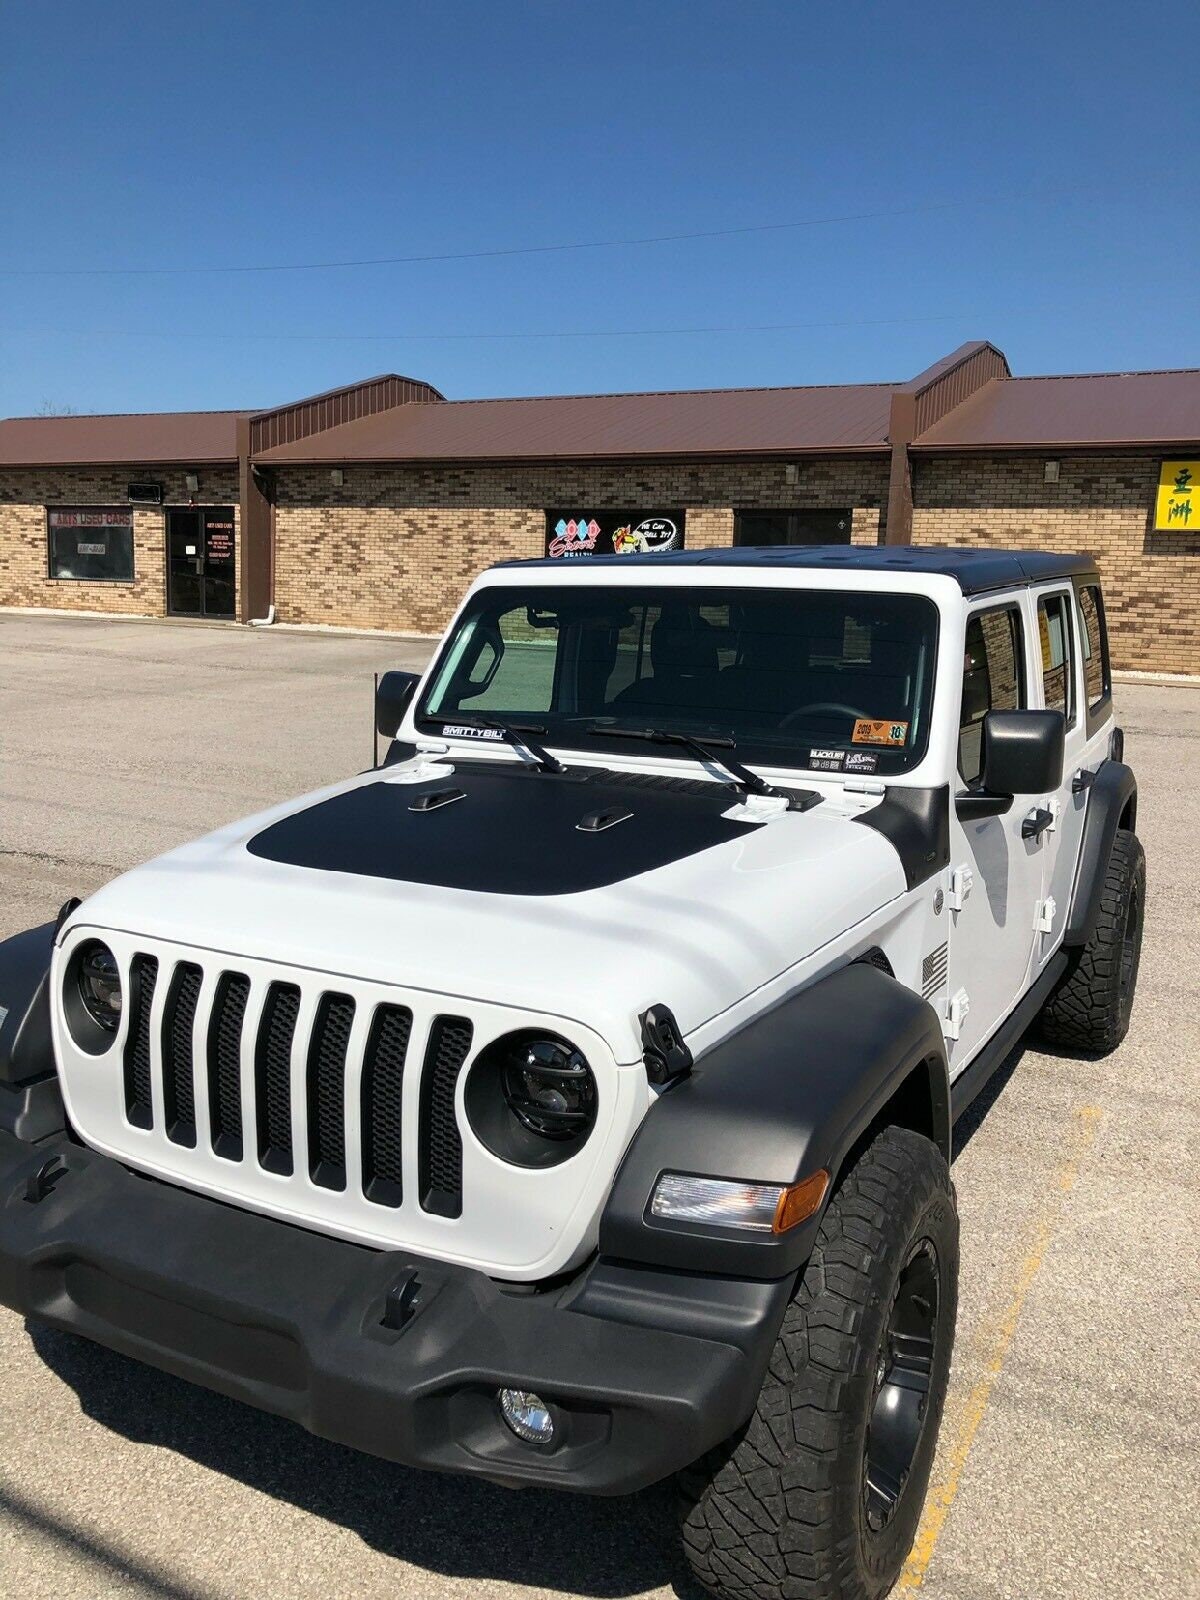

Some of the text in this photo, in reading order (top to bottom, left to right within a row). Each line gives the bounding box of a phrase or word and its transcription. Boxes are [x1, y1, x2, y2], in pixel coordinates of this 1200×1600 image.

[80, 513, 103, 525] USED
[106, 512, 131, 525] CARS
[891, 726, 901, 739] 10
